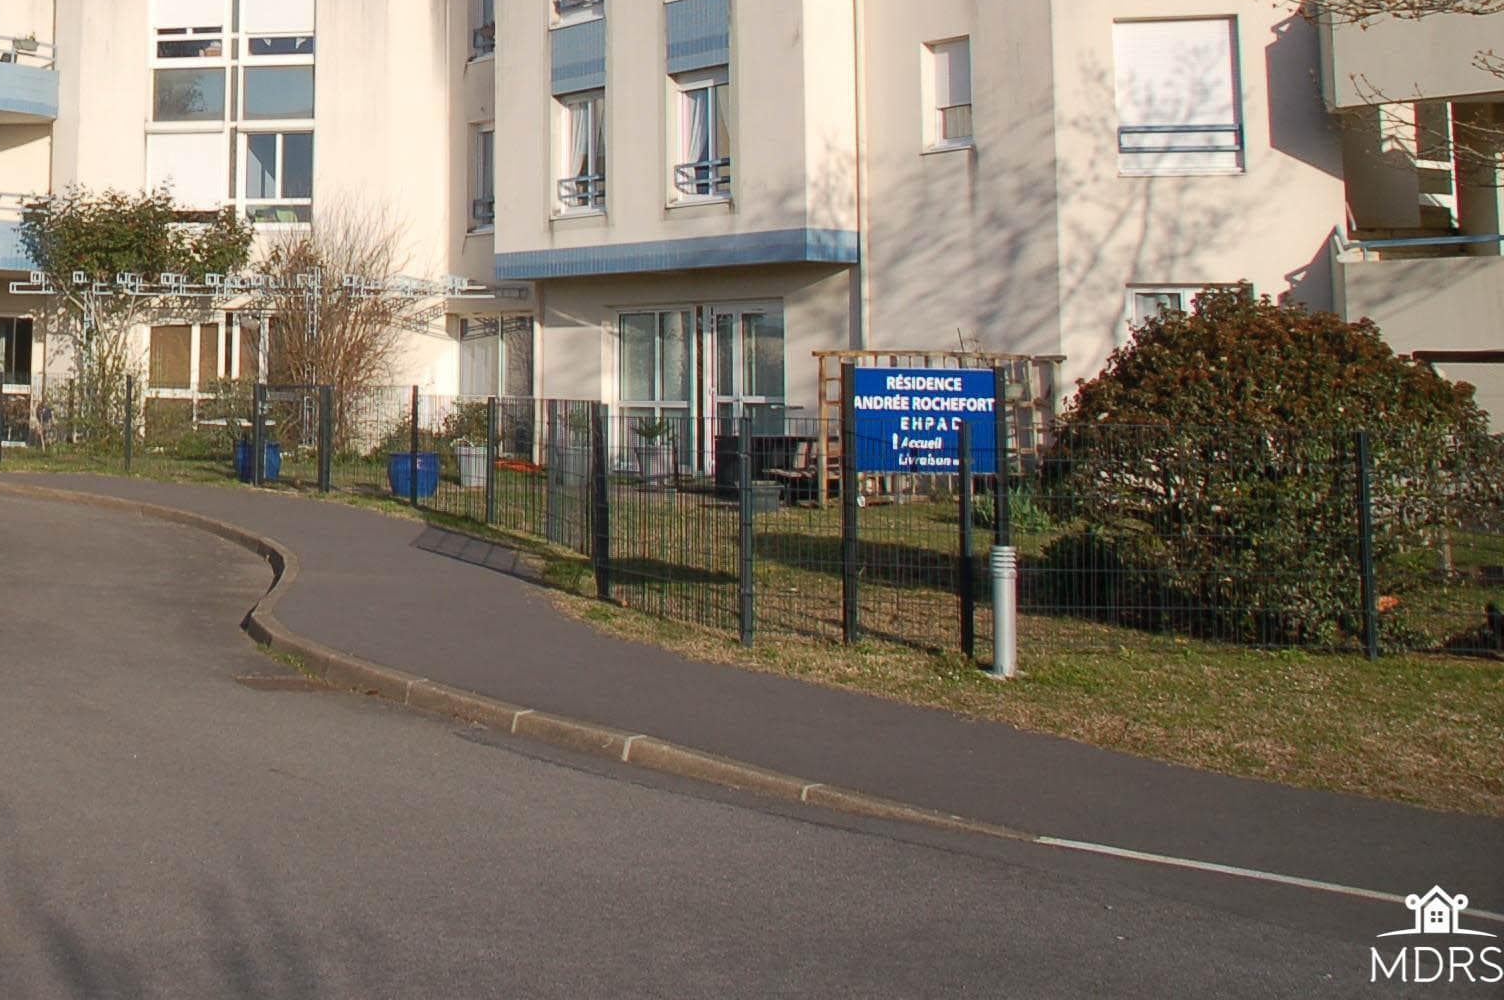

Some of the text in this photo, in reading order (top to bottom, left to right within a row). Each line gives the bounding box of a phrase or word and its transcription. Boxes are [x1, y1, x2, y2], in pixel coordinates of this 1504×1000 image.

[886, 374, 962, 392] RÉSIDENCE
[854, 394, 995, 412] ANDRÉE ROCHEFORT
[901, 437, 942, 449] Accueil
